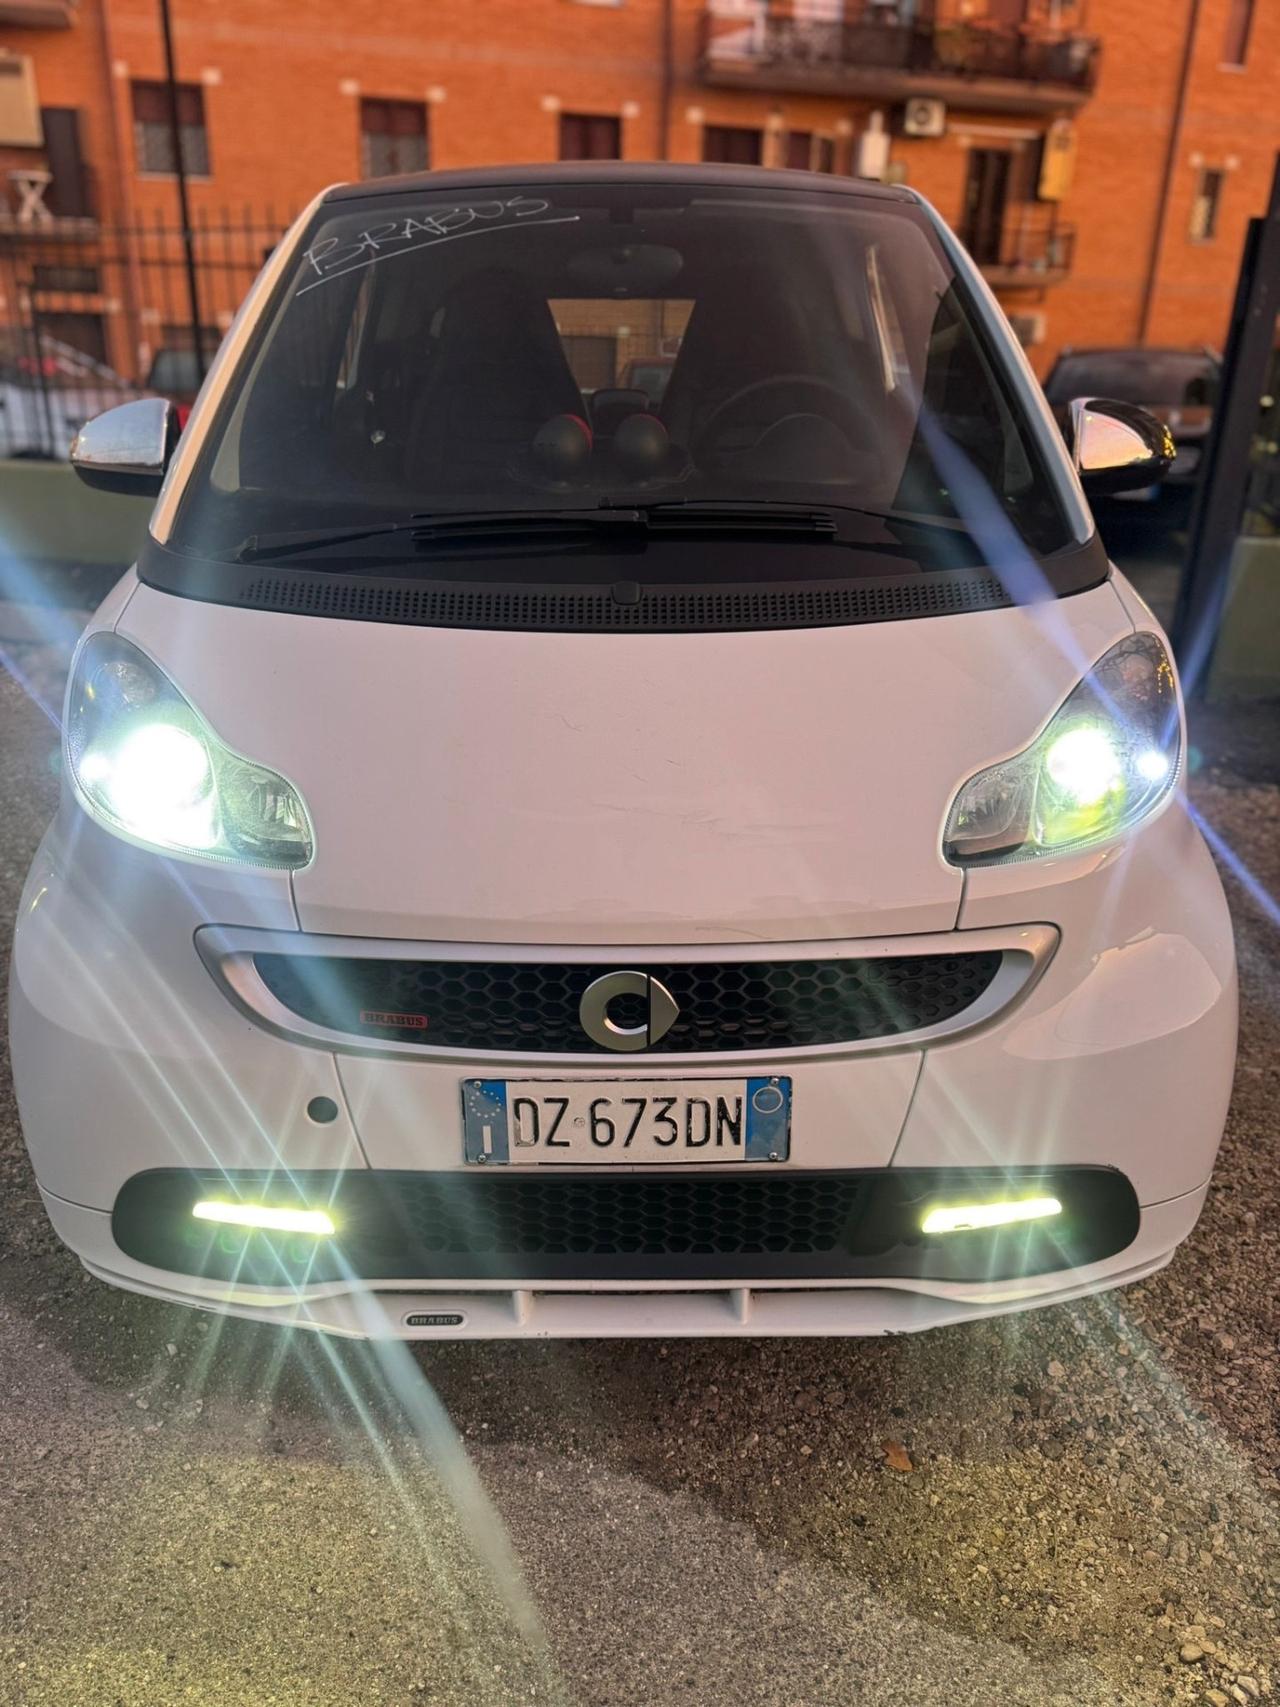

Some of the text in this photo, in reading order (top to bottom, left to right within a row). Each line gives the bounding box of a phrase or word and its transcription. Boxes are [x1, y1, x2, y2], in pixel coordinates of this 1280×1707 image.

[302, 195, 549, 275] BRABUS
[364, 1012, 424, 1026] BRABUS
[482, 1126, 493, 1154] I
[410, 1316, 459, 1325] BRABUS
